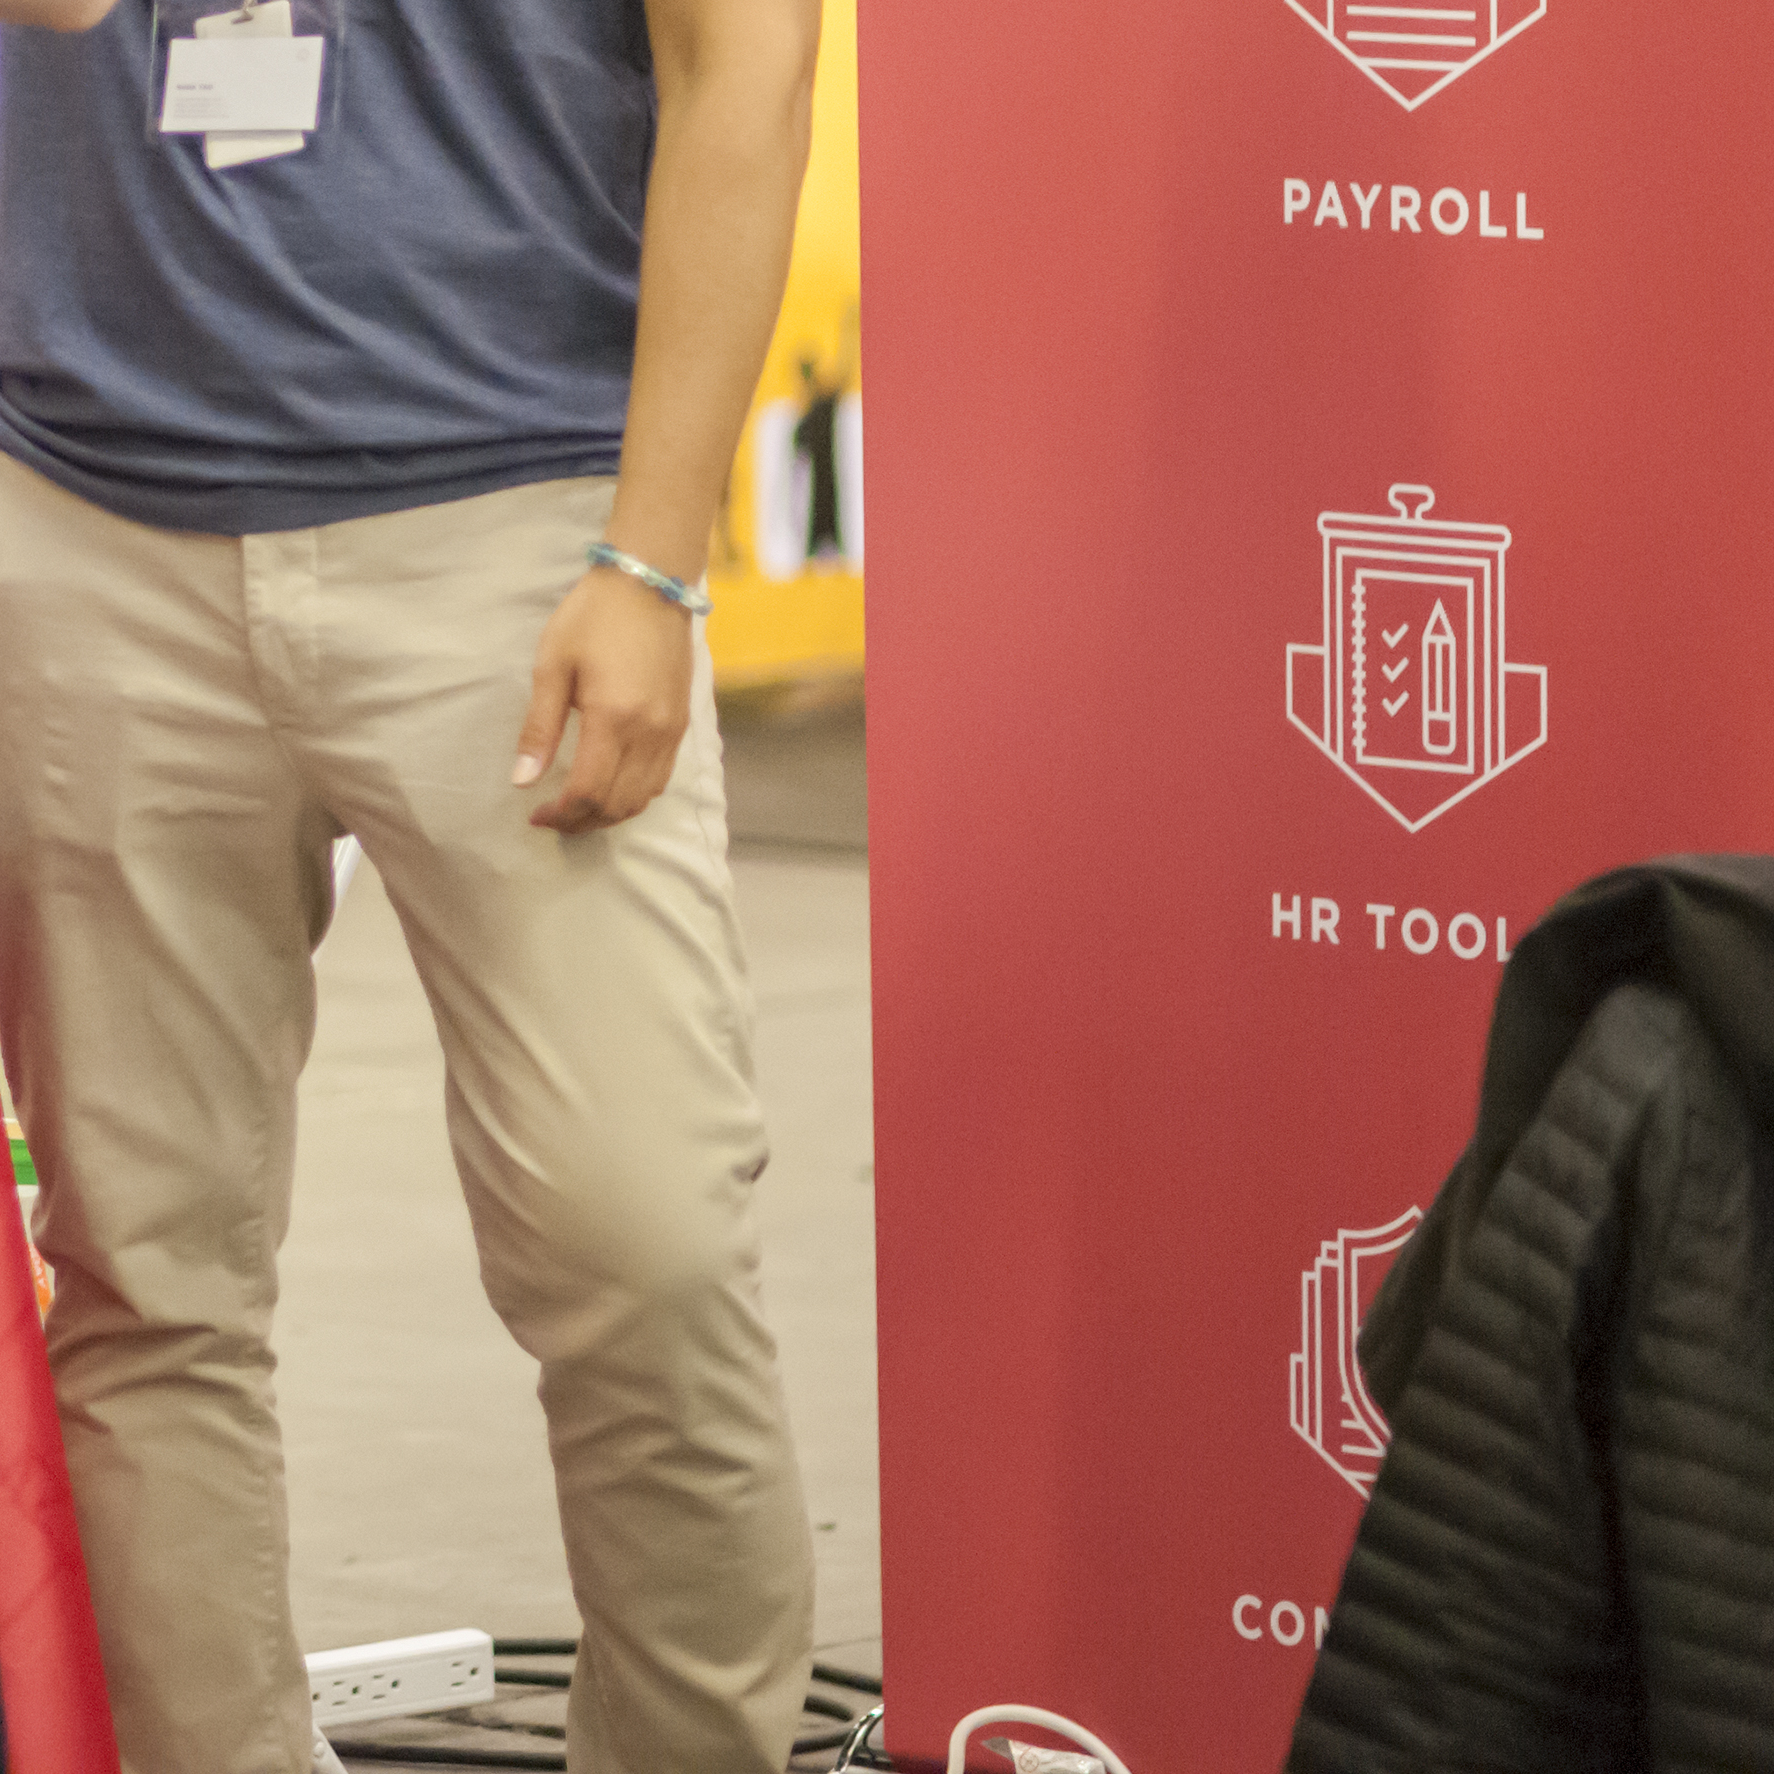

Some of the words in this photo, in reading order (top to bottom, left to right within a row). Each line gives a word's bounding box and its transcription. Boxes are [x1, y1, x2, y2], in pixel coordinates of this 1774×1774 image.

[1283, 178, 1545, 241] PAYROLL
[1271, 892, 1341, 946] HR
[1365, 903, 1512, 963] TOOL
